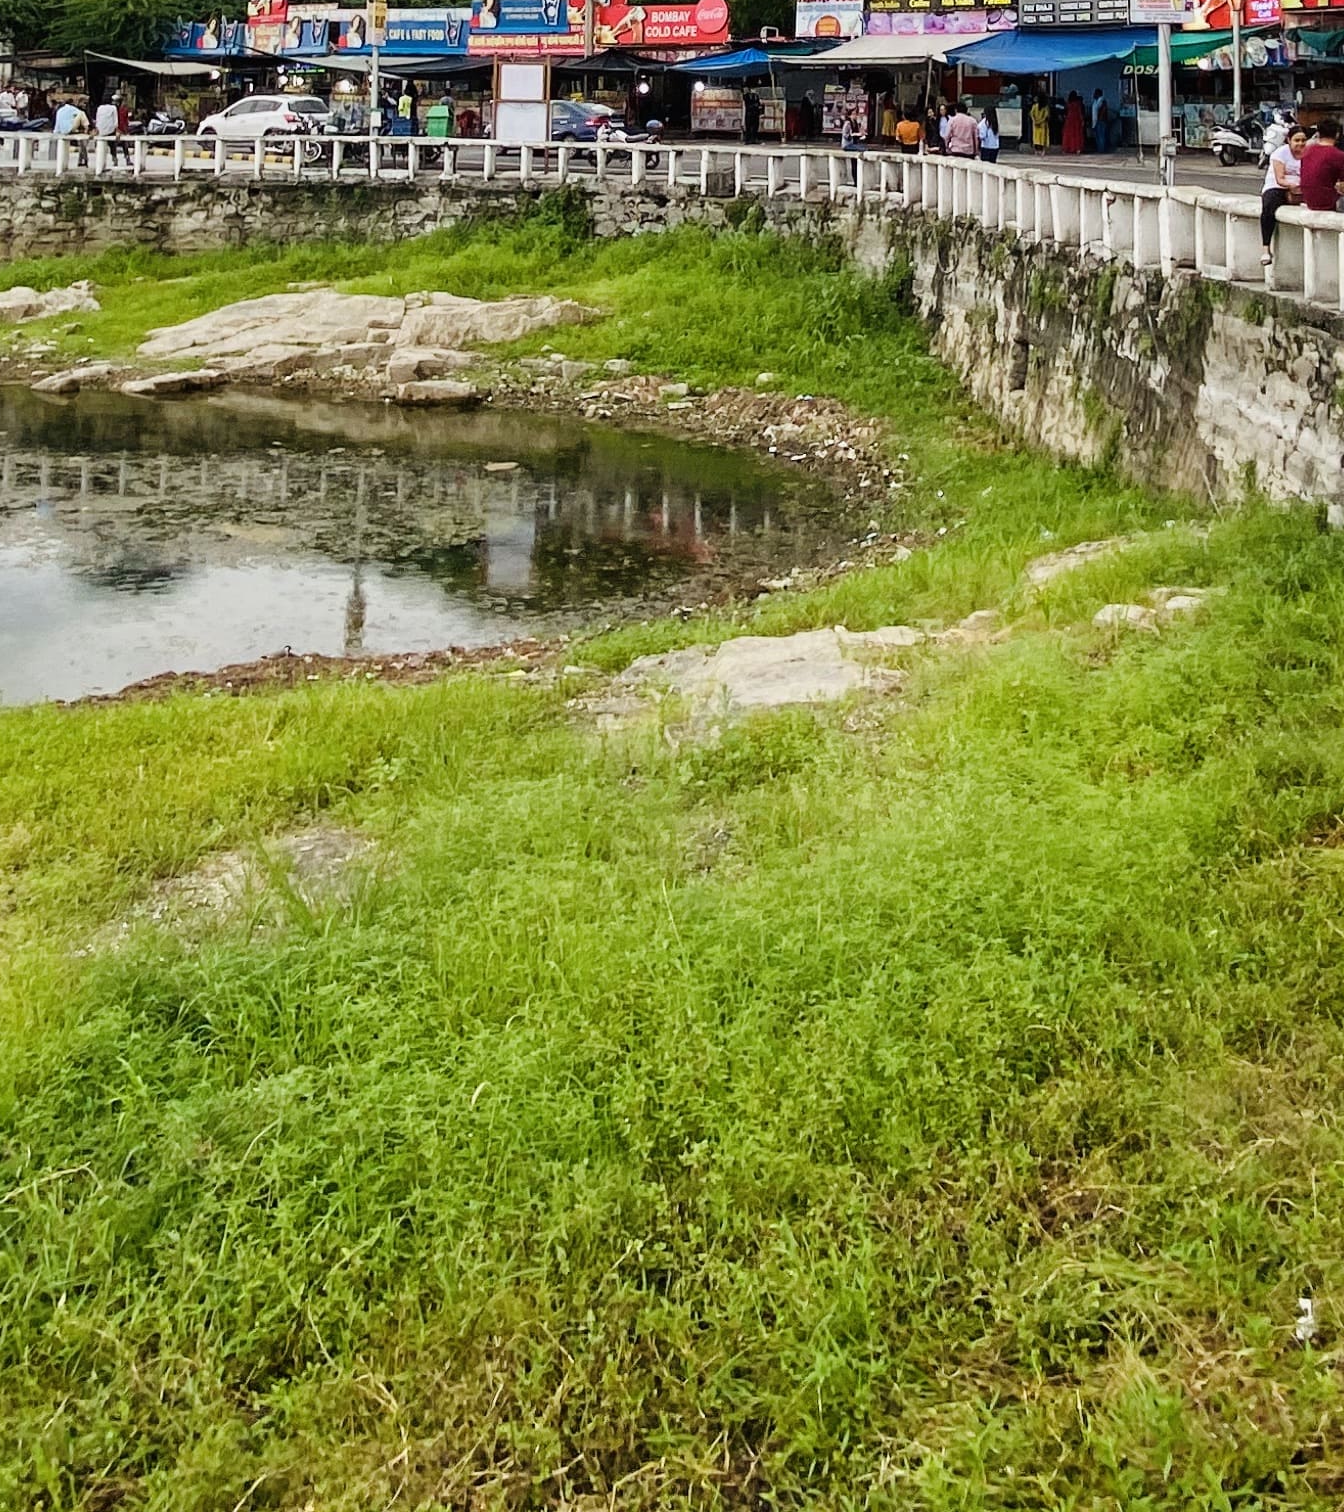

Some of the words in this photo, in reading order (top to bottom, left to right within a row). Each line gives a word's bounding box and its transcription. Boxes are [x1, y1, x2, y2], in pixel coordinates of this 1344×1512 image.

[651, 11, 691, 22] BOMBAY
[645, 26, 672, 37] COLD
[673, 25, 697, 37] CAFE
